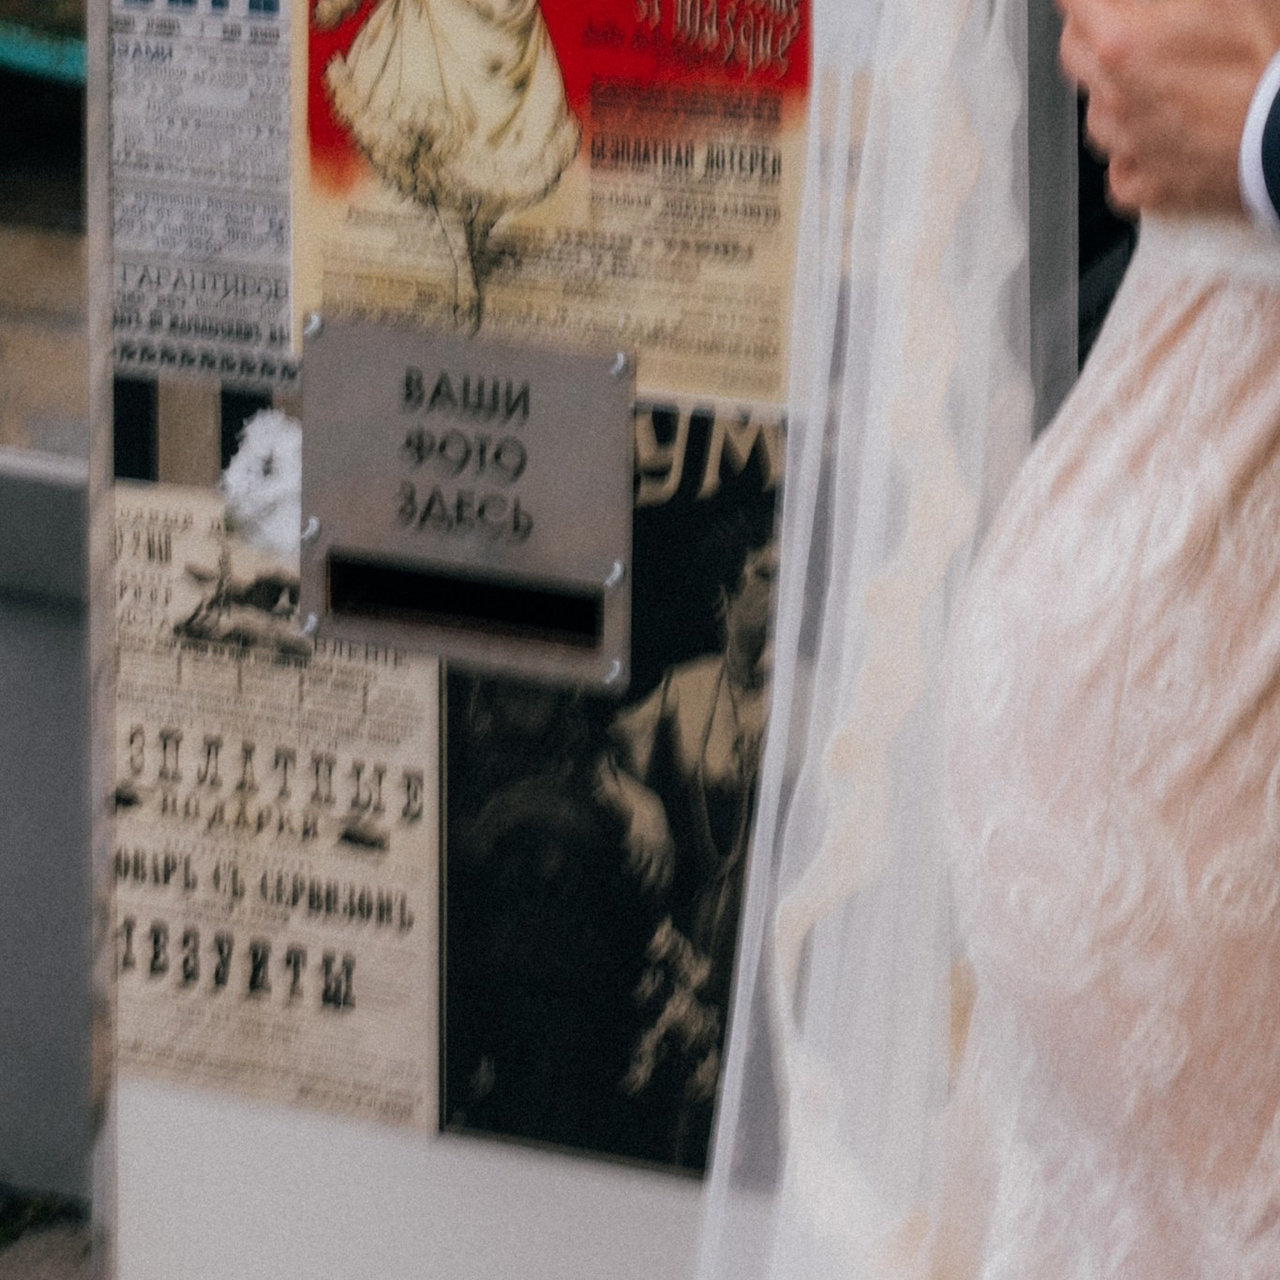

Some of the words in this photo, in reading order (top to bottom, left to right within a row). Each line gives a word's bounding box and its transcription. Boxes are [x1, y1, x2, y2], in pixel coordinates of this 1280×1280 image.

[404, 365, 531, 425] ВАШИ
[401, 424, 529, 486] ФОТО
[398, 478, 535, 545] ЗДЕСЬ
